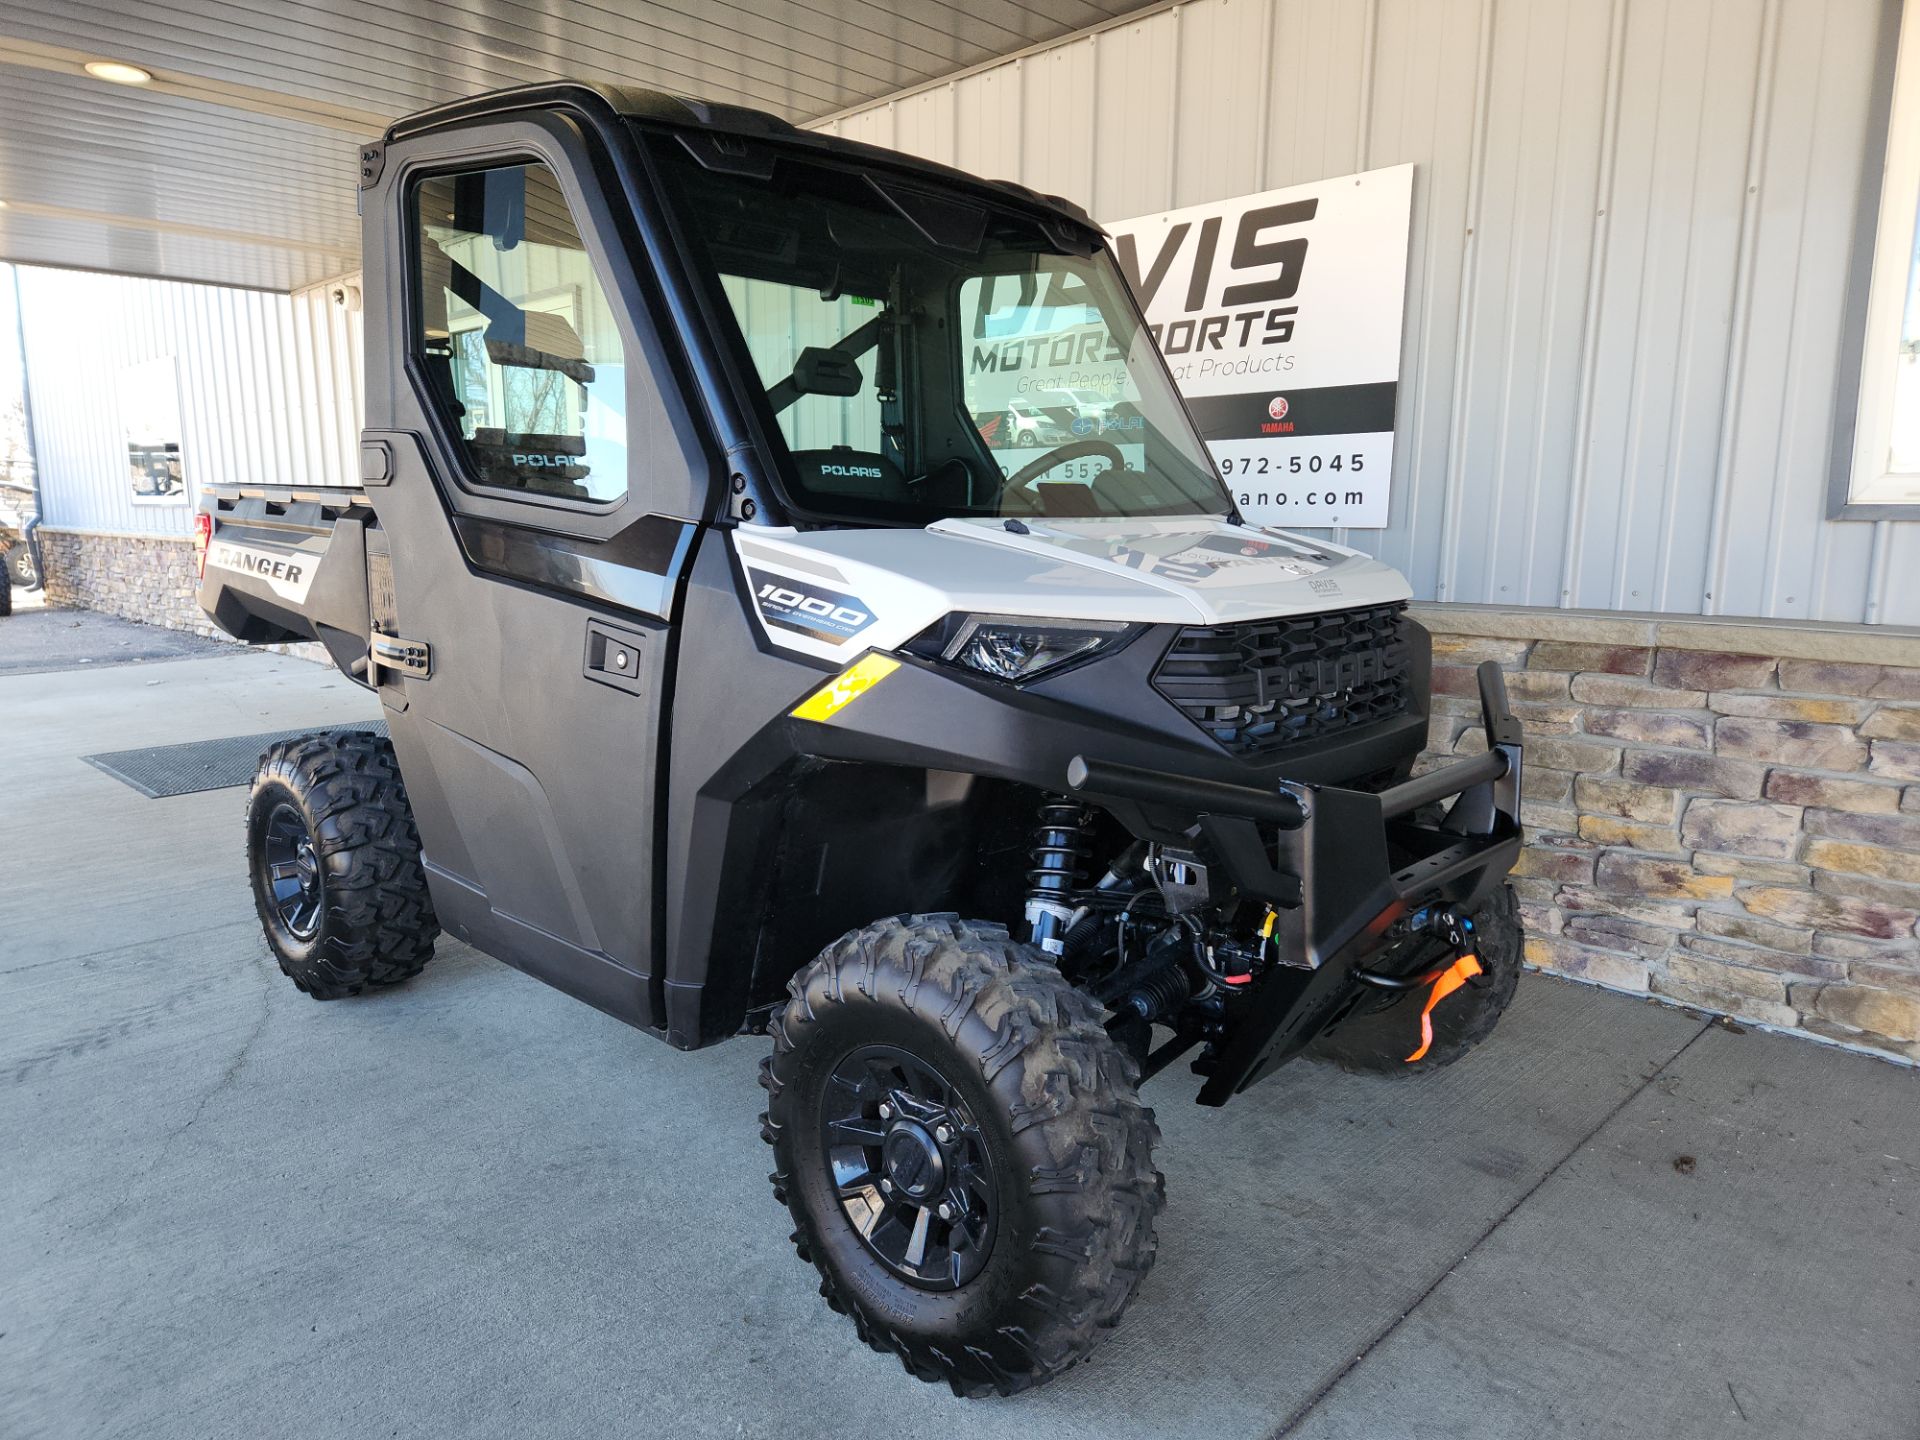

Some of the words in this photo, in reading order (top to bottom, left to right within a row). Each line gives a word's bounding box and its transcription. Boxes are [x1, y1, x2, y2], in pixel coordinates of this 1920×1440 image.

[1017, 373, 1064, 394] Great
[1199, 354, 1296, 378] Products
[1261, 422, 1294, 433] YAMAHA
[821, 465, 881, 478] POLARIS
[1221, 453, 1364, 475] 972-5045
[217, 548, 303, 584] RANGER
[758, 584, 868, 626] 1000
[1258, 644, 1404, 706] POLARIS
